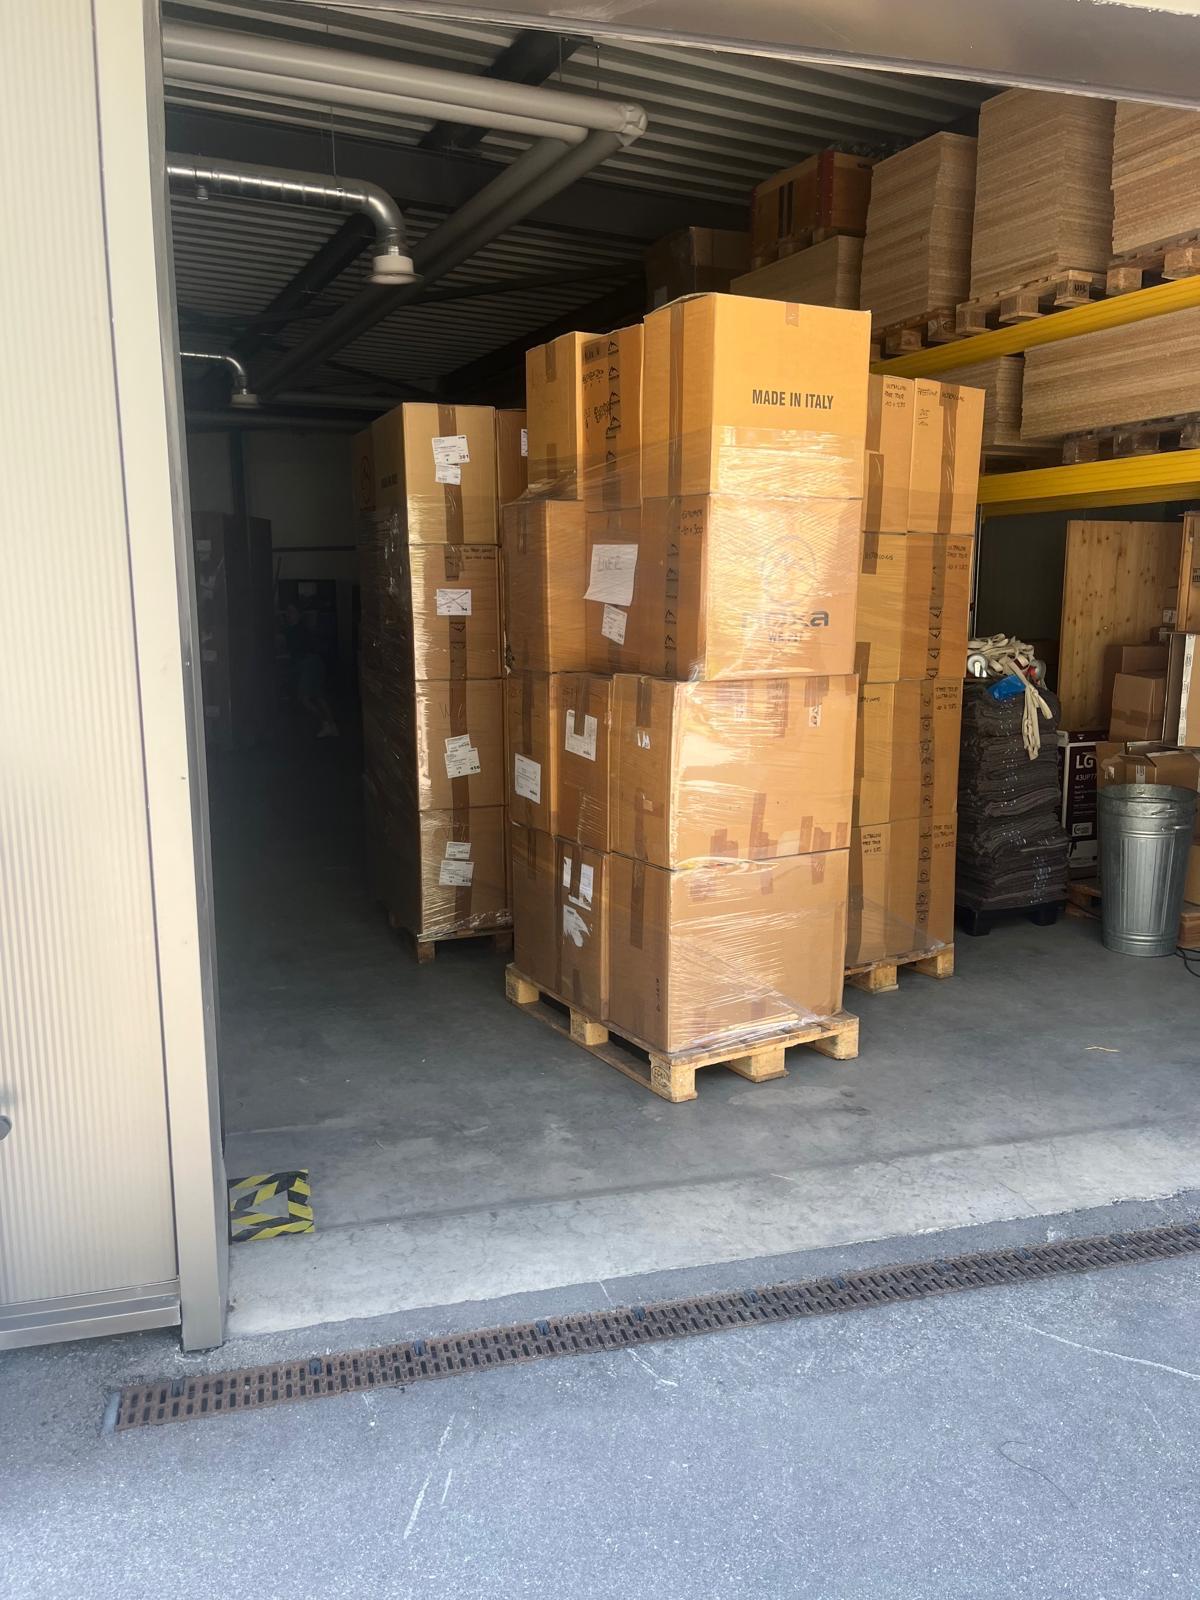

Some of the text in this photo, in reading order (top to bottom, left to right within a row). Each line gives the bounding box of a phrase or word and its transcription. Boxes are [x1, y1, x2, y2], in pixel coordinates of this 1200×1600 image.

[752, 389, 834, 410] MADE IN ITALY
[1076, 755, 1093, 768] LG
